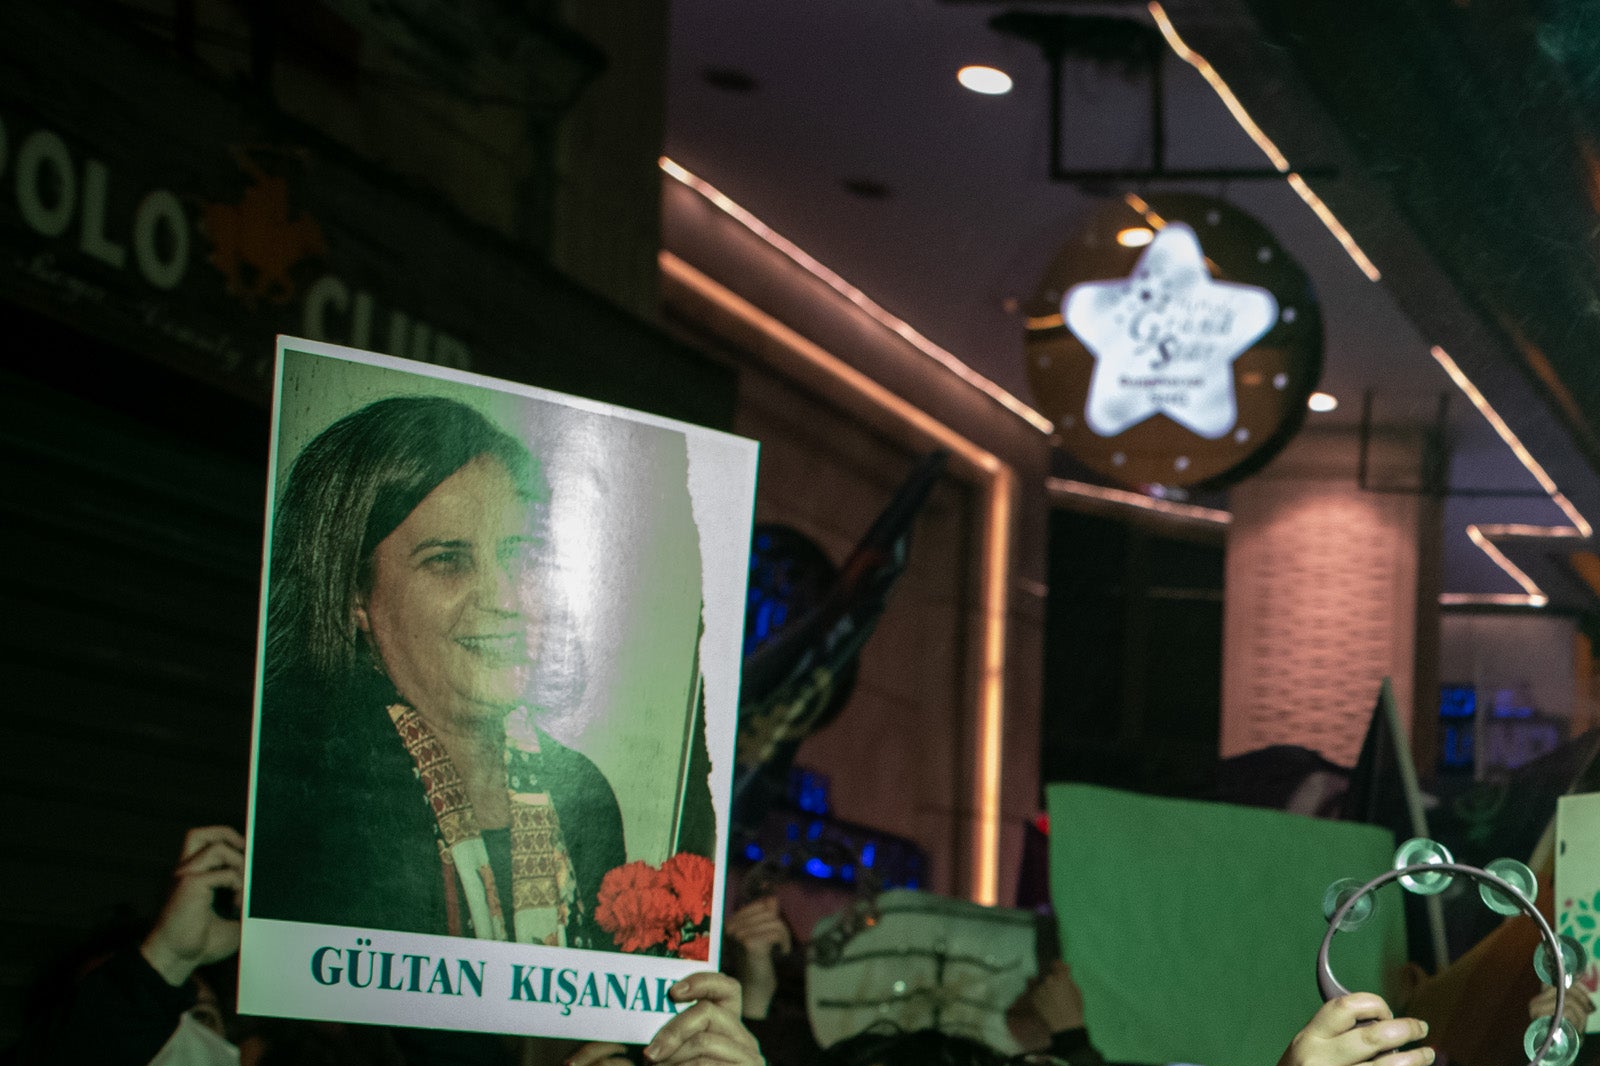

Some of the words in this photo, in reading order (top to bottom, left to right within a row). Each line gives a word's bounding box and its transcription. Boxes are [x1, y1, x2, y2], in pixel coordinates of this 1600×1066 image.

[0, 115, 190, 291] OLO
[310, 938, 487, 998] GÜLTAN
[509, 963, 679, 1016] KIŞANAK
